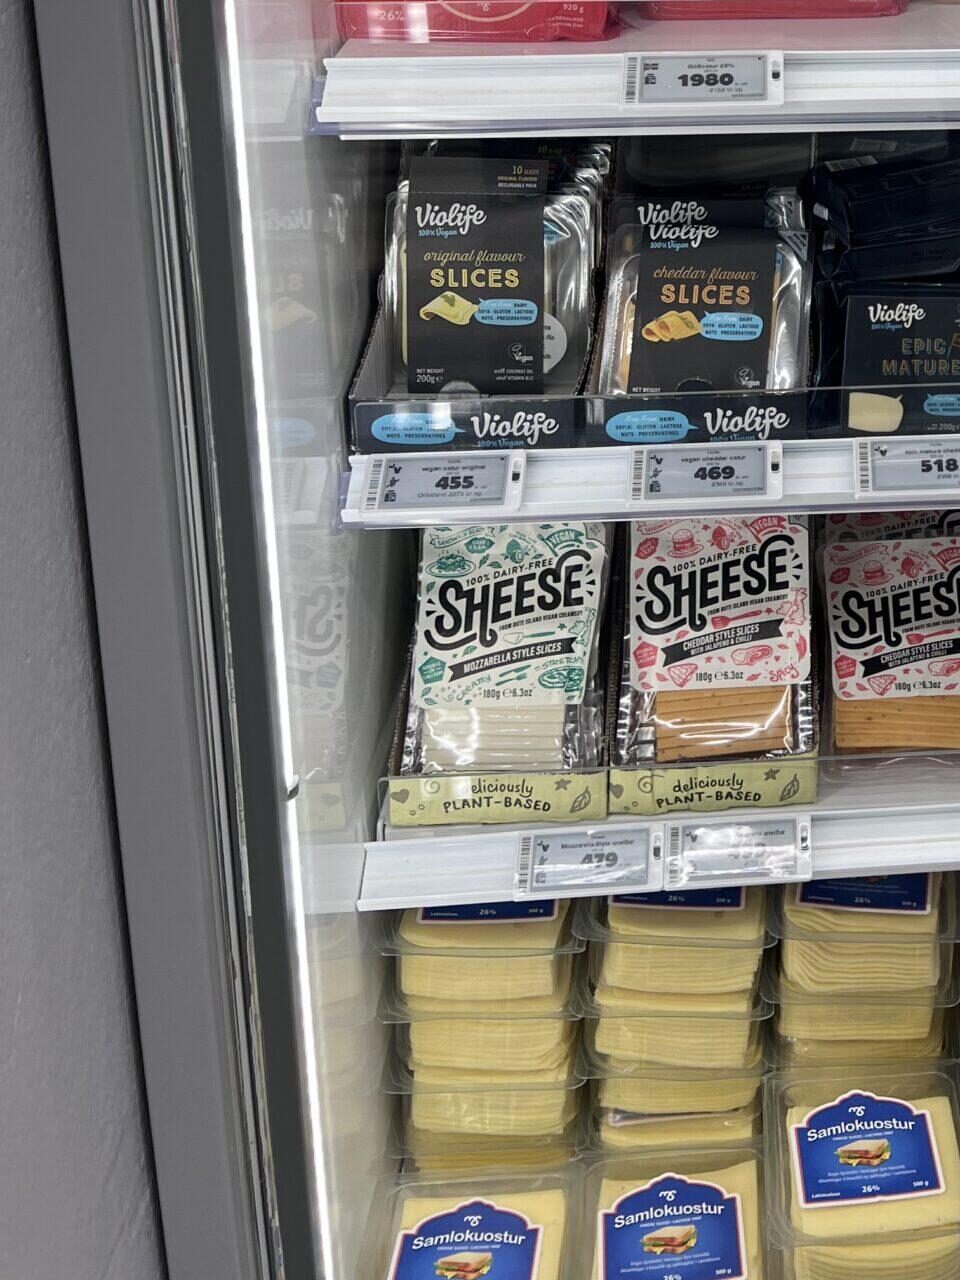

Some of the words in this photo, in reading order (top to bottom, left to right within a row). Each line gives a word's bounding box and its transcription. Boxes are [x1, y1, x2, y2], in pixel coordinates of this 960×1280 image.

[677, 73, 734, 87] 1980
[415, 203, 487, 235] Violife
[638, 201, 706, 227] Violife
[418, 227, 437, 237] 100%
[437, 227, 458, 239] Vegan
[648, 223, 719, 249] Violife
[667, 240, 689, 251] Vegan
[423, 249, 473, 267] original
[474, 249, 527, 267] flavour
[430, 268, 520, 288] SLICES
[653, 266, 704, 281] cheddar
[706, 266, 760, 285] flavour
[660, 283, 751, 305] SLICES
[868, 302, 926, 328] Violife
[901, 337, 947, 355] EPIC
[416, 374, 436, 385] 200g
[470, 411, 559, 446] Violife
[703, 406, 790, 441] Violife
[693, 466, 736, 481] 469
[920, 458, 960, 473] 518
[434, 475, 475, 490] 455
[753, 516, 778, 531] VEGAN
[550, 529, 575, 545] VEGAN
[672, 559, 697, 574] 100%
[699, 544, 758, 566] DAIRY-FREE
[466, 573, 491, 587] 100%
[493, 558, 555, 581] DAIRY-FREE
[635, 533, 795, 636] SHEESE
[866, 587, 888, 598] 100%
[890, 572, 946, 593] DAIRY-FREE
[424, 549, 592, 651] SHEESE
[683, 633, 715, 651] CHEDDAR
[715, 628, 737, 643] STYLE
[736, 623, 760, 638] SLICES
[463, 653, 512, 674] MOZZARELLA
[512, 647, 535, 661] STYLE
[535, 642, 562, 656] SLICES
[881, 647, 911, 664] CHEDDAR
[910, 643, 931, 659] STYLE
[930, 639, 954, 656] SLICES
[695, 672, 713, 683] 180g
[483, 688, 501, 700] 180g
[673, 773, 744, 794] deliciously
[443, 796, 552, 814] PLANT-BASED
[656, 791, 762, 809] PLANT-BASED
[581, 851, 619, 868] 479
[806, 1118, 916, 1142] Samlokuostur
[861, 1184, 881, 1193] 26%
[613, 1202, 725, 1229] Samlokuostur
[411, 1229, 526, 1250] Samlokuostur
